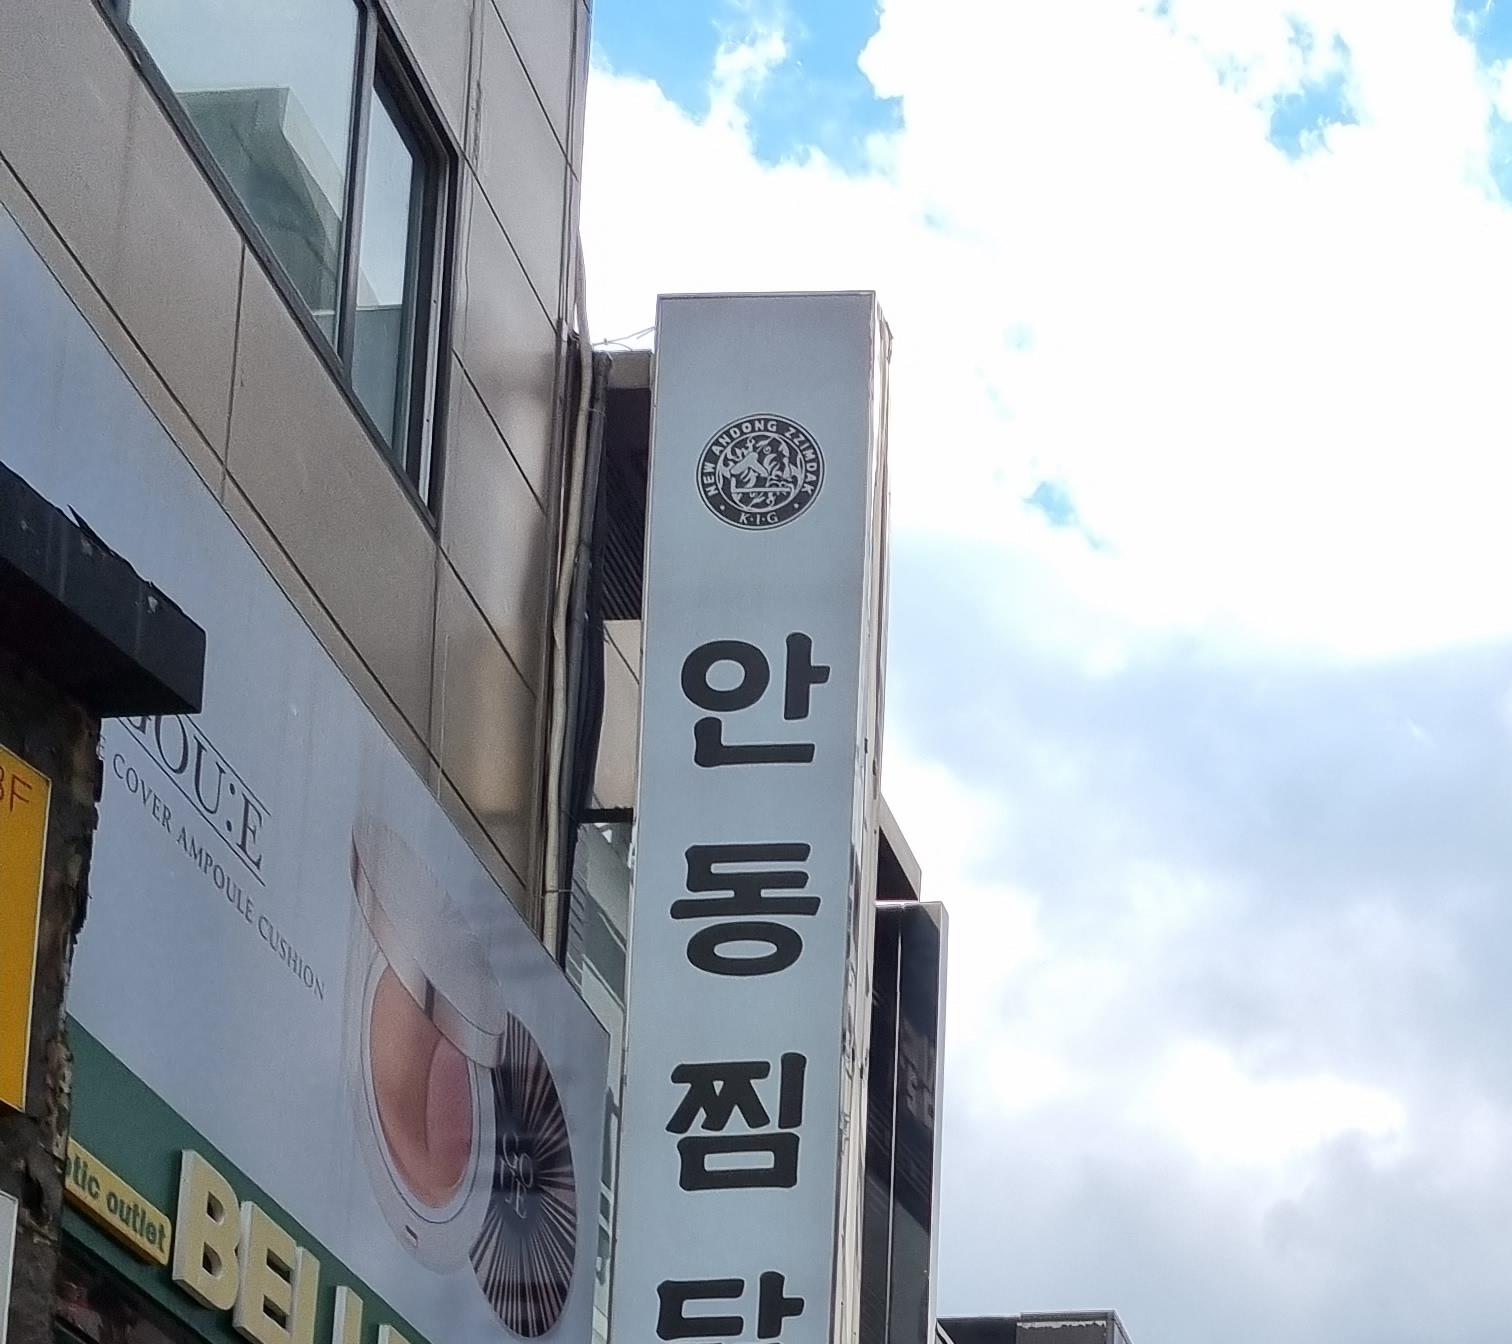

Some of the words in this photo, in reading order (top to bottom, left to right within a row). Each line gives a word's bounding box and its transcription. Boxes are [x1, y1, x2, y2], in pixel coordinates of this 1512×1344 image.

[710, 419, 779, 457] ANDONG
[786, 425, 818, 496] ZZIMDAK
[112, 752, 172, 834] COVER
[175, 826, 254, 924] AMPOULE
[257, 914, 325, 1001] CUSHION
[105, 1187, 168, 1255] outlet
